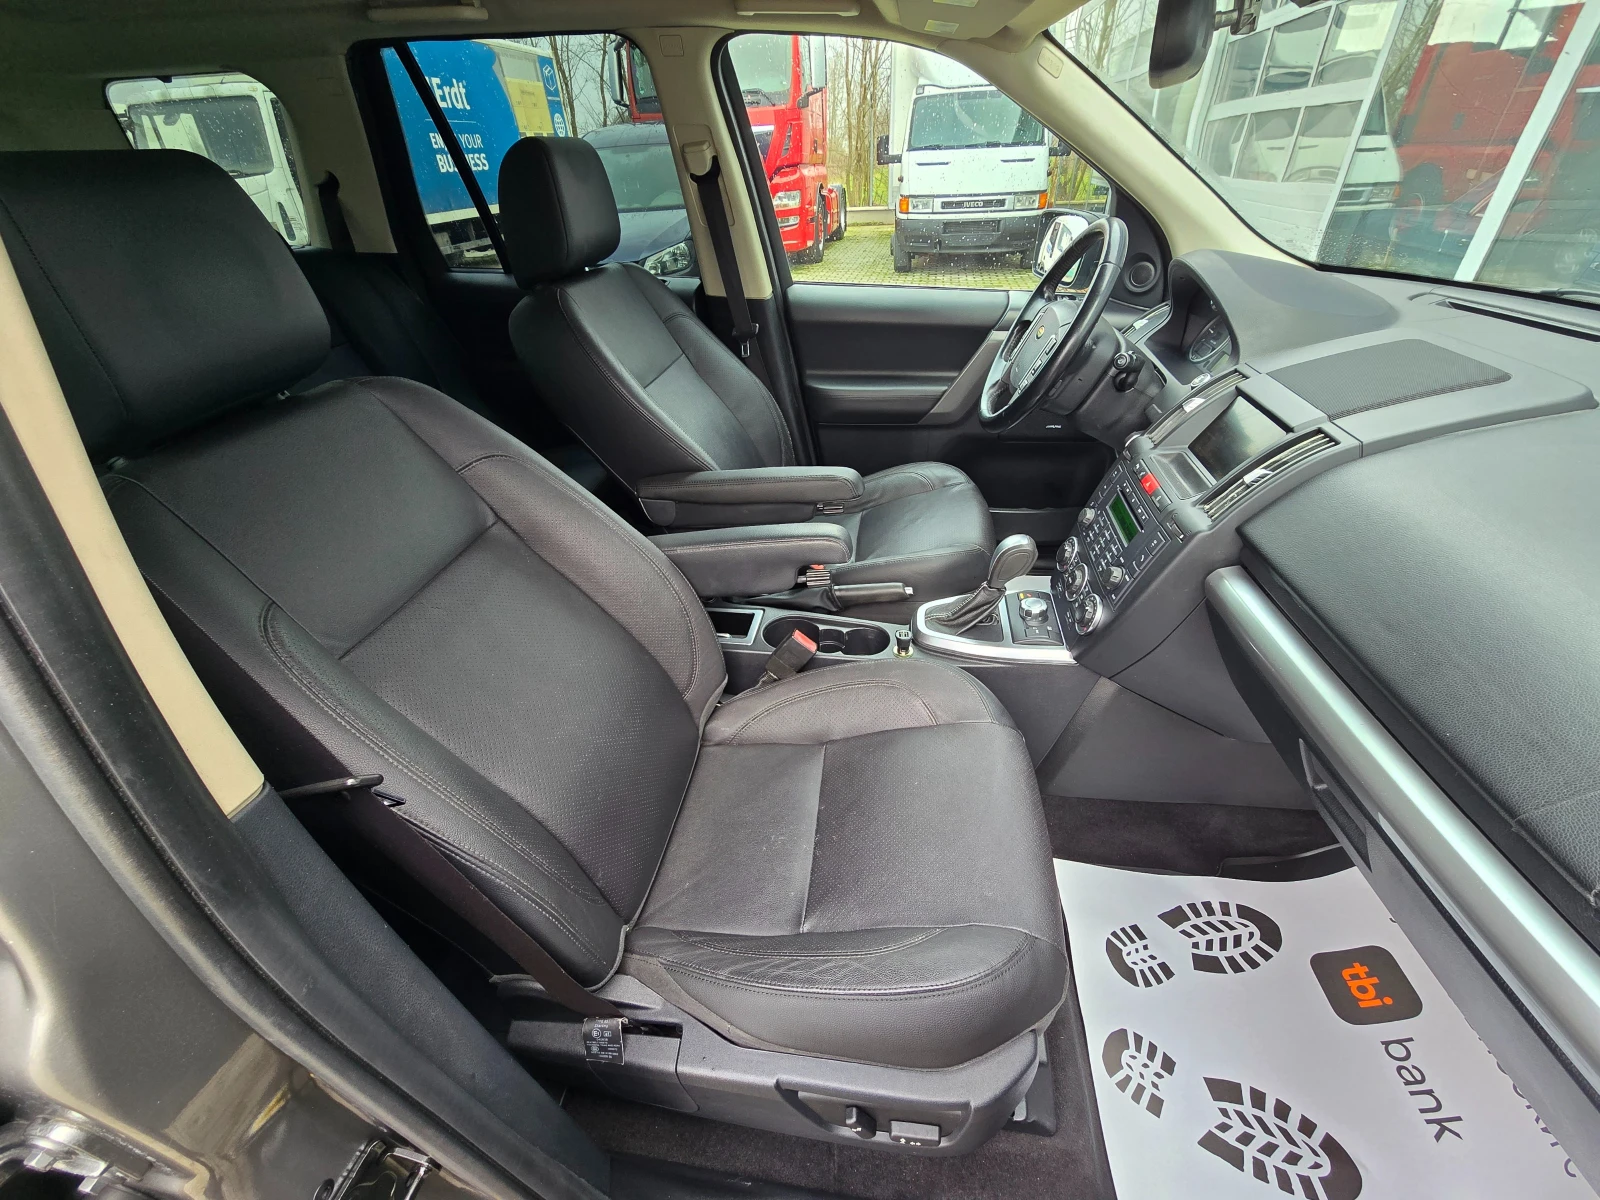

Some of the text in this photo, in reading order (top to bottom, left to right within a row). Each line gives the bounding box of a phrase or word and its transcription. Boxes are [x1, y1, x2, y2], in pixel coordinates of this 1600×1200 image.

[458, 133, 484, 149] YOUR
[1341, 962, 1393, 1008] tbi
[1380, 1036, 1464, 1143] bank
